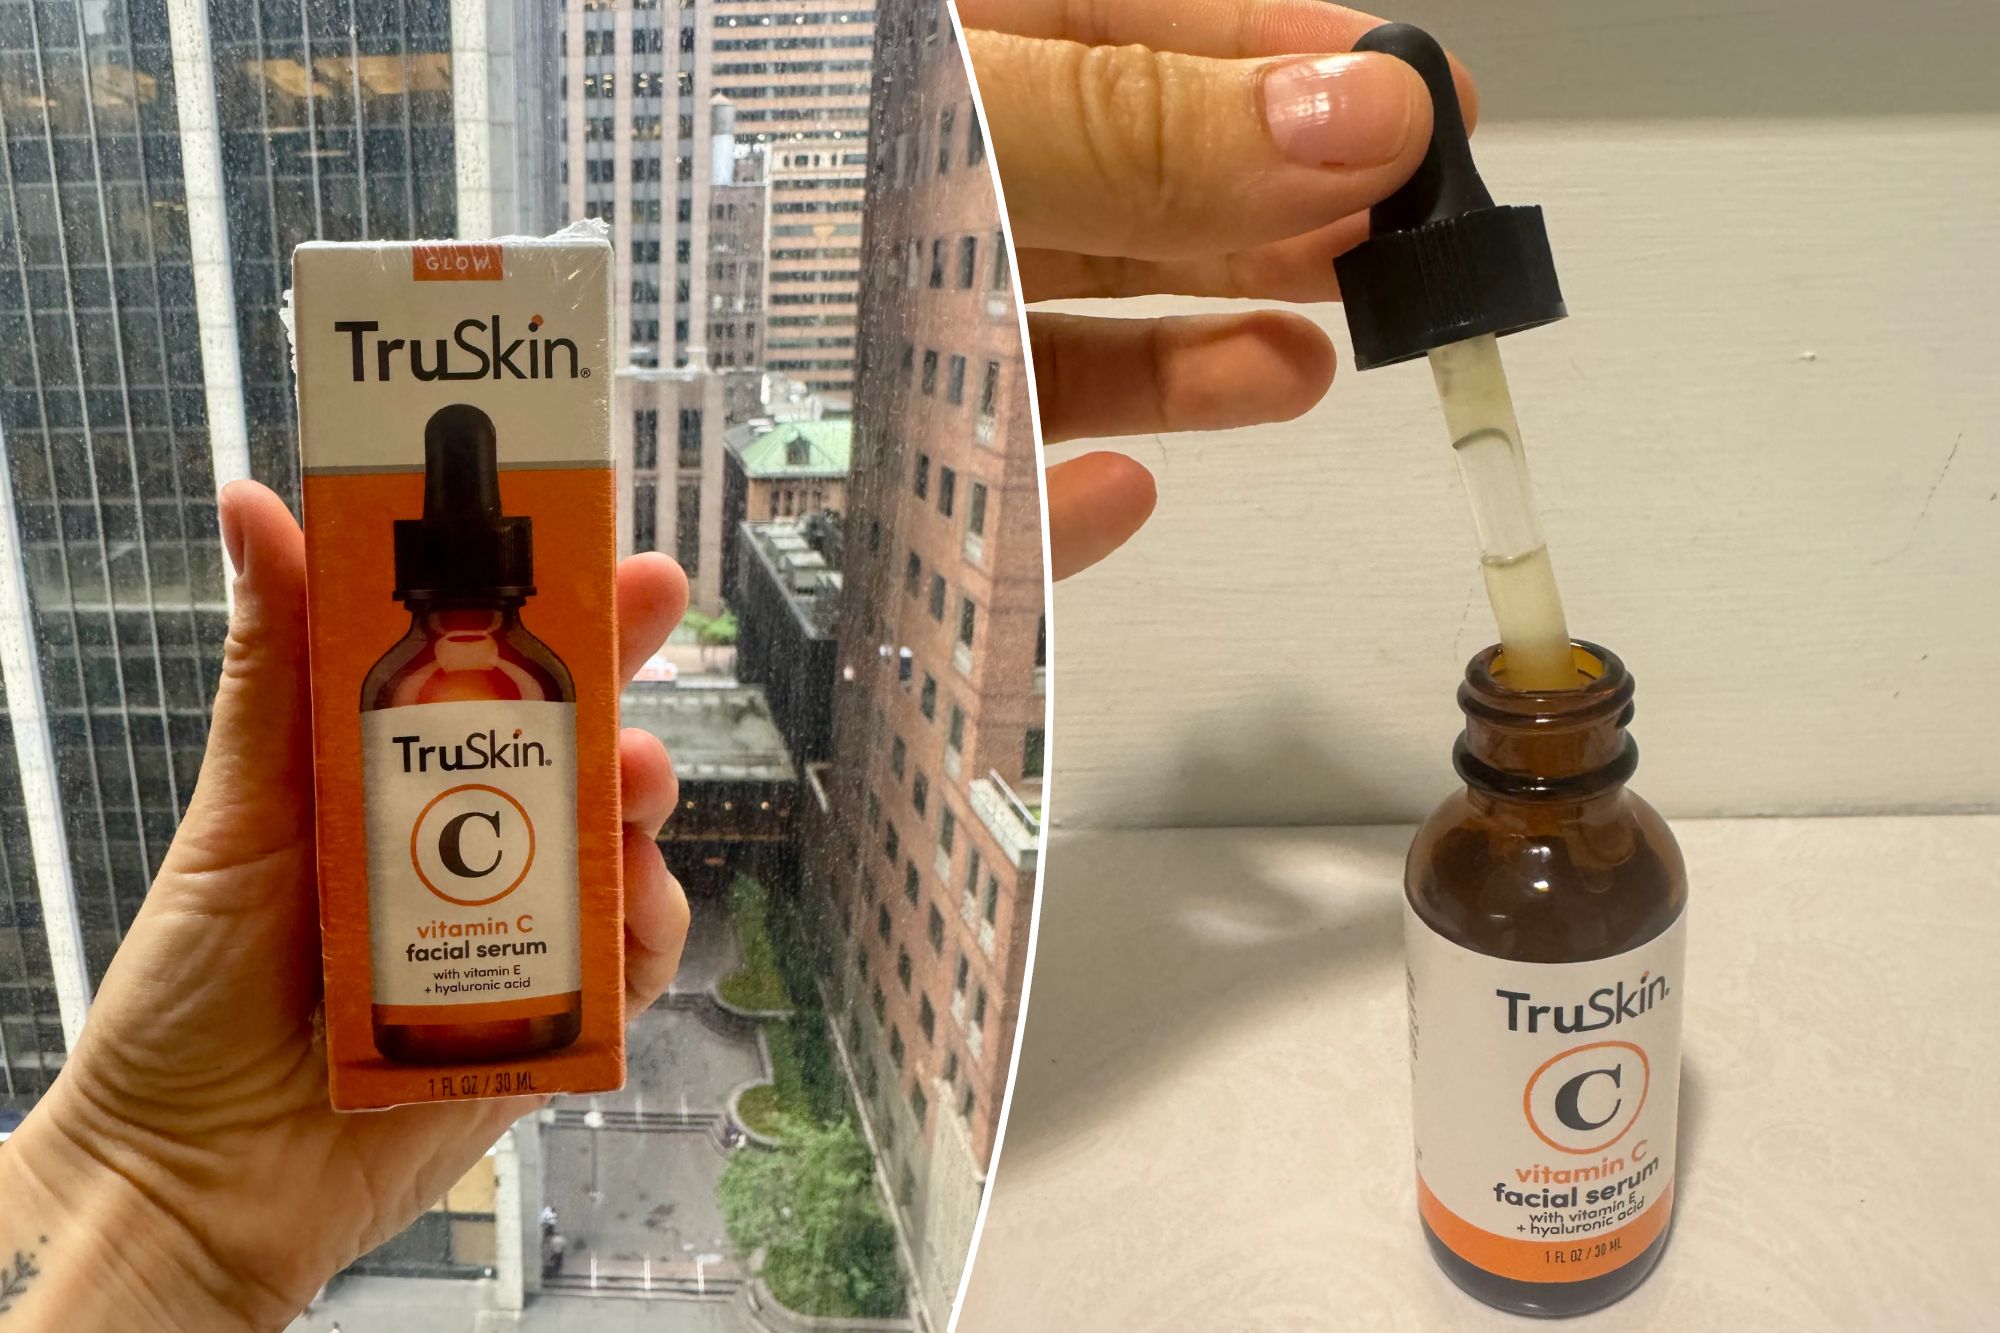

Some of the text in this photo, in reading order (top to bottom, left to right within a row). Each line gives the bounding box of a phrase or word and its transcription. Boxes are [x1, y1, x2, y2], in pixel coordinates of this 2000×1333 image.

[424, 255, 491, 272] GLOW
[438, 810, 503, 879] C
[417, 914, 534, 939] vitamin C
[406, 940, 547, 962] facial serum
[433, 965, 521, 980] with vitamin E
[435, 979, 500, 996] hyaluronic
[504, 977, 531, 989] acid
[428, 1072, 536, 1097] 1 FL OZ / 30 ML
[1554, 1063, 1622, 1131] C
[1515, 1139, 1648, 1185] vitamin C
[1493, 1157, 1659, 1209] facial serum
[1517, 1196, 1645, 1238] + hyaluronic acid
[1529, 1191, 1636, 1223] with vitamin E
[1545, 1250, 1550, 1263] 1
[1555, 1251, 1566, 1263] FL
[1570, 1248, 1583, 1262] OZ
[1594, 1243, 1607, 1258] 30
[1609, 1236, 1622, 1252] ML
